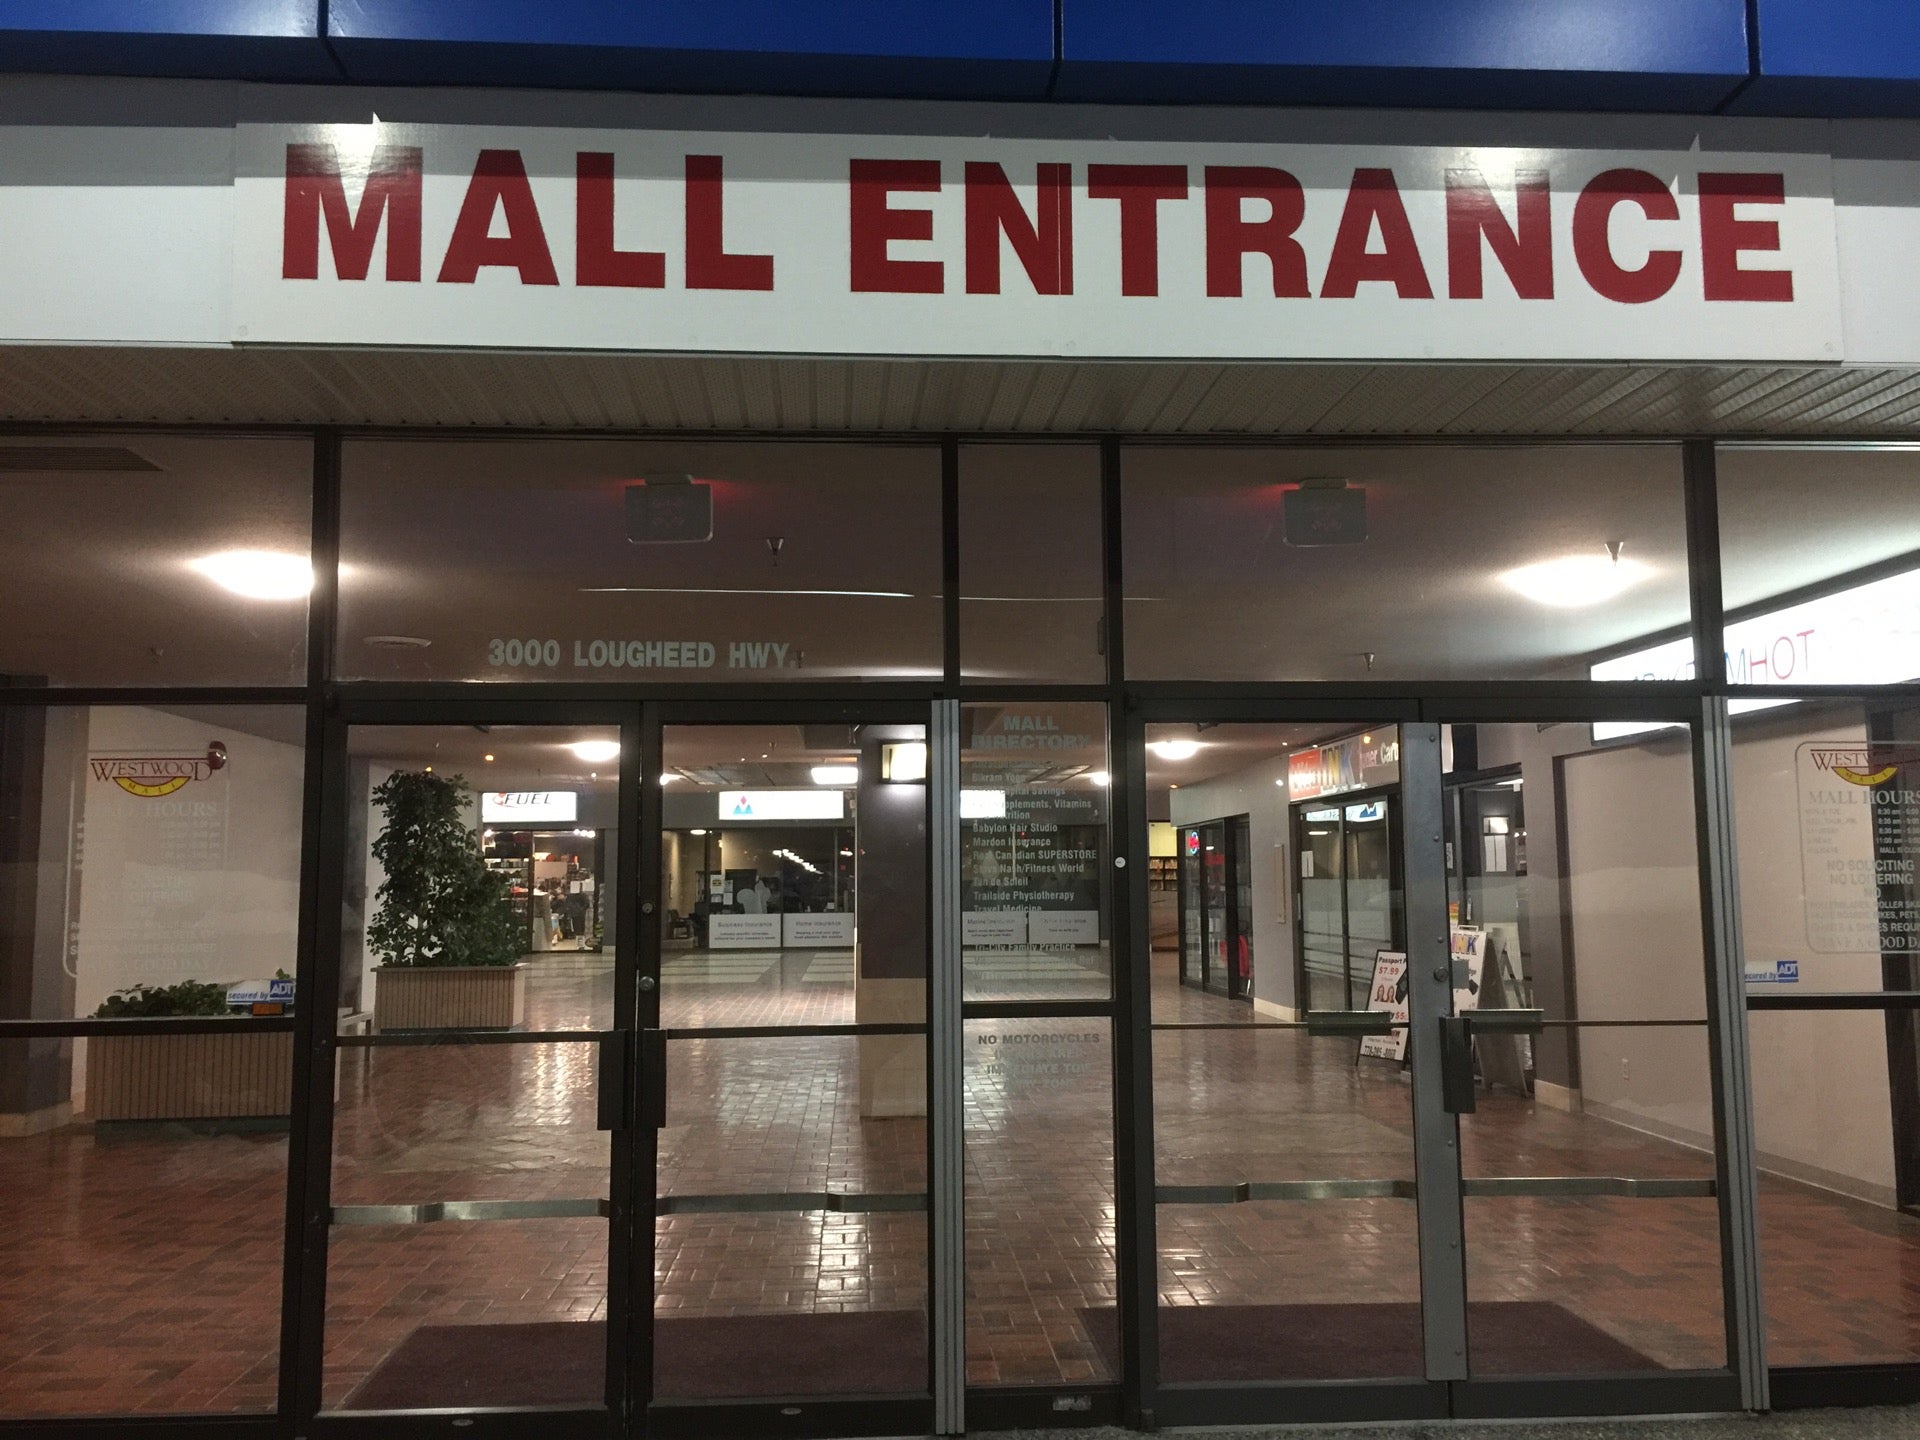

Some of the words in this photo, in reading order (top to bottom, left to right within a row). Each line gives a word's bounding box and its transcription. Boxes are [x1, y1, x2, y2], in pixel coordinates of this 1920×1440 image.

[281, 143, 775, 291] MALL
[849, 158, 1794, 304] ENTRANCE
[487, 638, 561, 667] 3000
[574, 640, 716, 668] LOUGHEED
[1003, 715, 1059, 731] MALL
[971, 734, 1090, 750] DIRECTORY
[90, 761, 213, 782] WESTWOOD
[1054, 799, 1093, 809] Vitamins
[1808, 790, 1858, 805] MALL
[146, 801, 218, 817] HOURS
[972, 823, 1007, 835] Babylon
[1009, 823, 1028, 833] Hair
[1030, 823, 1058, 833] Studio
[972, 837, 1006, 847] Mardon
[1037, 849, 1097, 860] SUPERSTORE
[1058, 863, 1085, 873] World
[973, 890, 1011, 901] Trailside
[1013, 890, 1075, 902] Physiotherapy
[1745, 971, 1767, 980] ecured
[1778, 963, 1798, 975] ADT
[270, 983, 294, 995] ADT
[977, 1034, 998, 1045] NO
[1001, 1033, 1101, 1045] MOTORCYCLES
